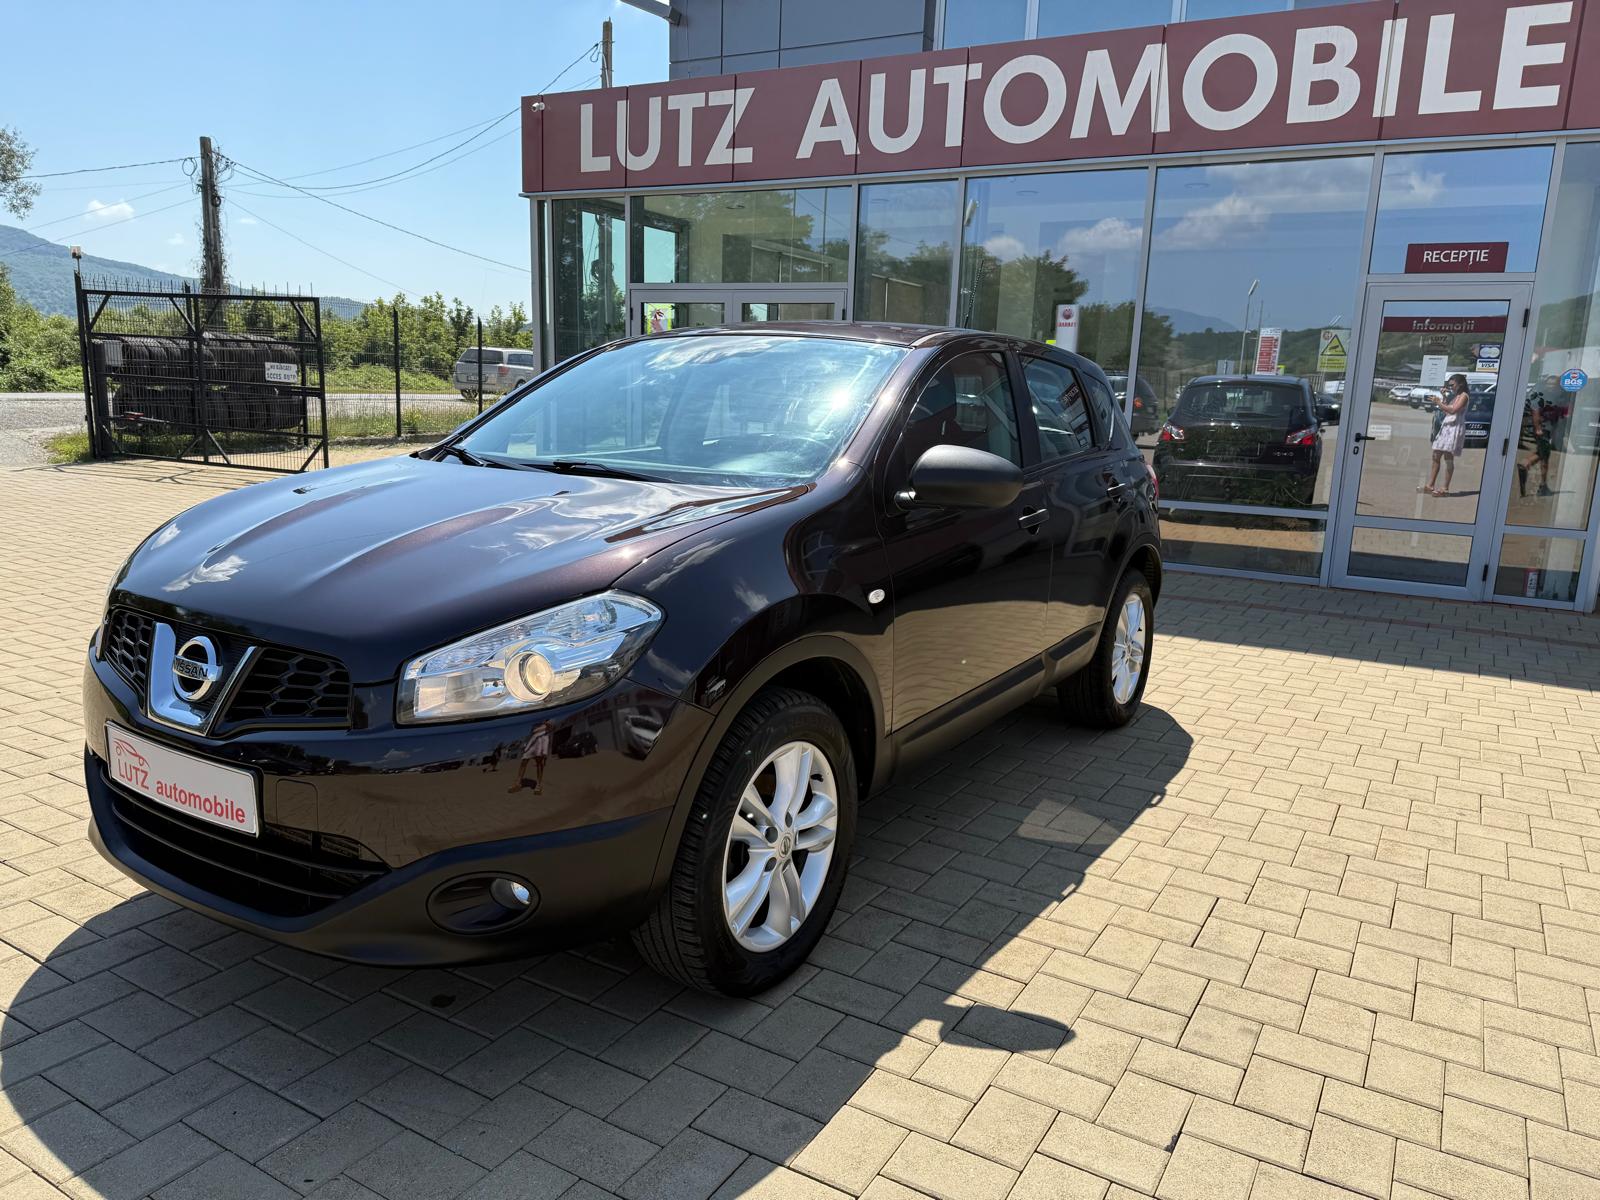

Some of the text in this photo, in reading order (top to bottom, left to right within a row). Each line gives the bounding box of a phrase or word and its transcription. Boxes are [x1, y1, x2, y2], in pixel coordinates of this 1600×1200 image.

[580, 1, 1574, 173] LUTZ AUTOMOBILE
[175, 658, 209, 678] NISSAN
[118, 757, 246, 824] LUTZ automobile
